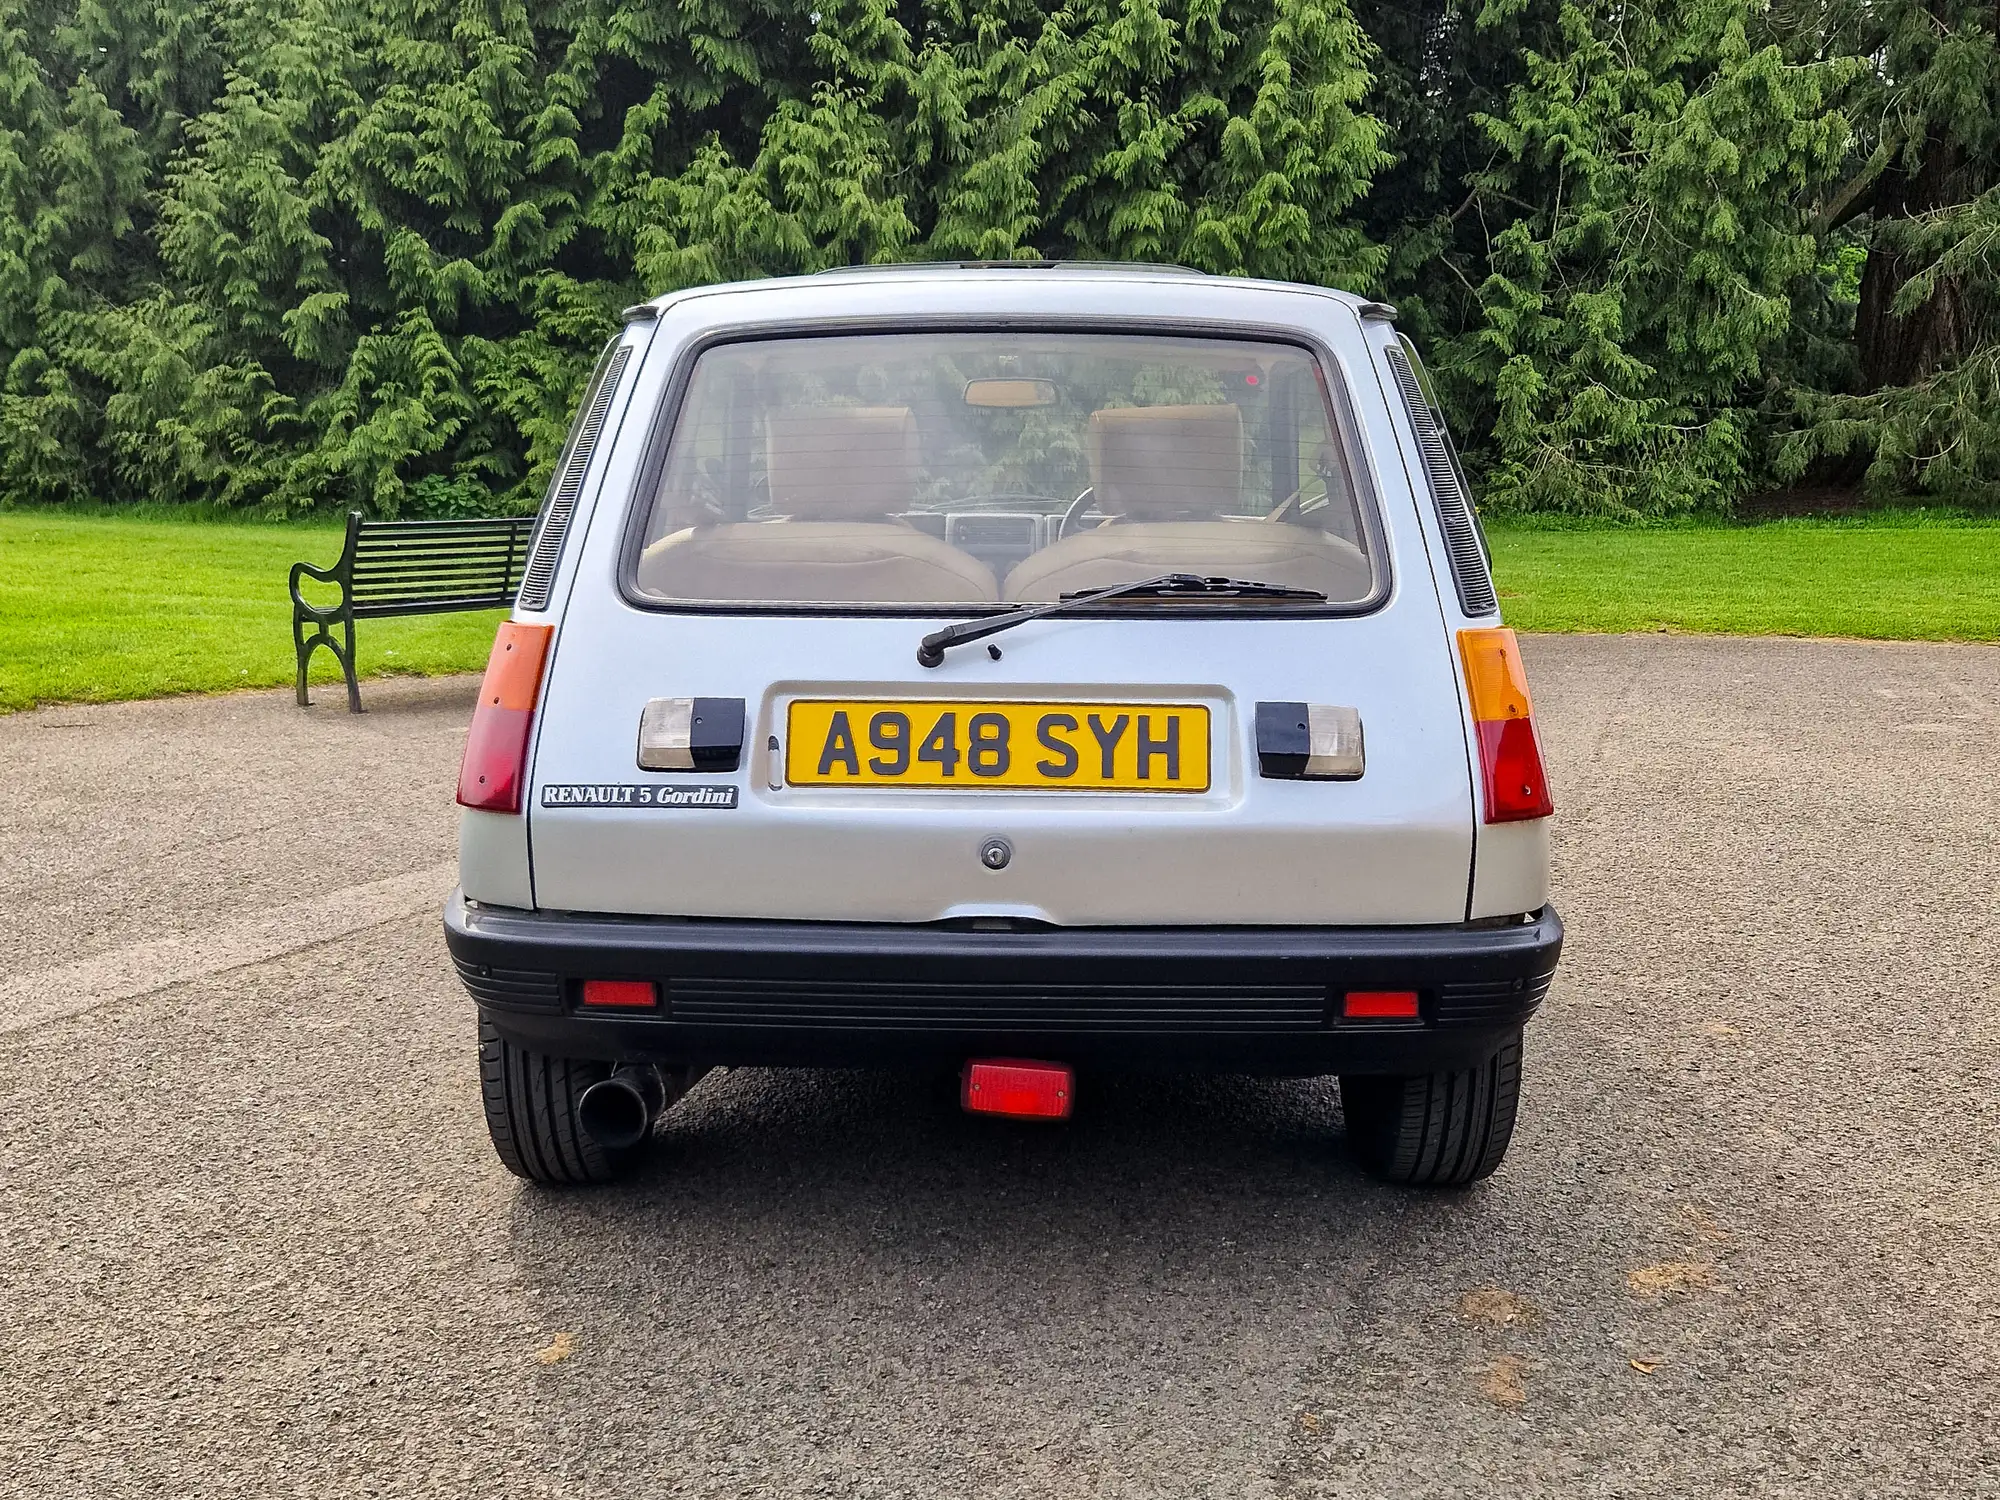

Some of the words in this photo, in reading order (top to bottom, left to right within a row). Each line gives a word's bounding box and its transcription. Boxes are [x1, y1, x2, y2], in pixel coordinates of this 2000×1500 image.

[816, 711, 1011, 778] A948
[1036, 713, 1180, 780] SYH
[543, 786, 635, 804] RENAULT
[639, 786, 652, 803] 5
[656, 786, 734, 805] Gordini
